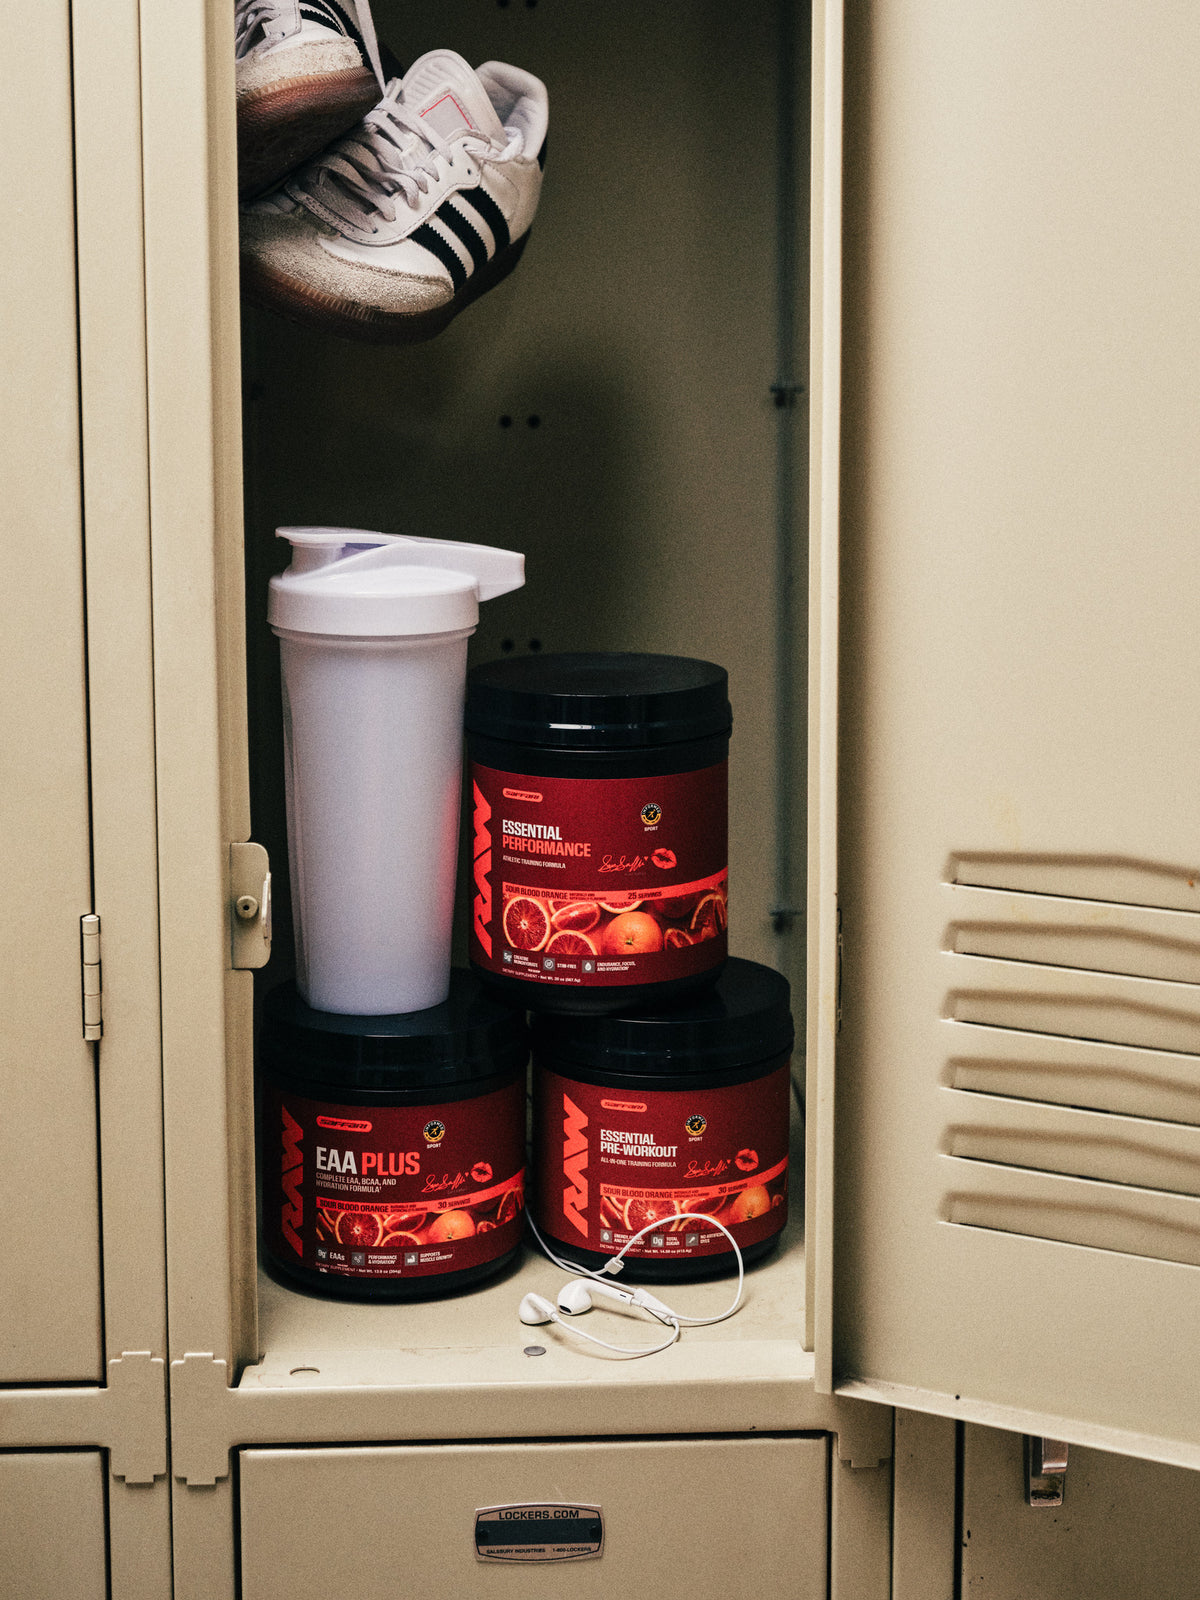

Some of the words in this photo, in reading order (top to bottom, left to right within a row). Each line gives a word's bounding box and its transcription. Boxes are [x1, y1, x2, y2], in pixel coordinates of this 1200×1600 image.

[502, 819, 562, 840] ESSENTIAL
[502, 834, 591, 857] PERFORMANCE
[502, 855, 521, 864] ATHLETIC
[521, 858, 542, 867] TRAINING
[542, 860, 566, 869] FORMULA
[505, 884, 520, 894] SOUR
[521, 887, 541, 897] BLOOD
[542, 890, 568, 900] ORANGE
[600, 1129, 656, 1145] ESSENTIAL
[600, 1141, 678, 1158] PRE-WORKOUT
[316, 1146, 357, 1174] EAA
[361, 1152, 420, 1176] PLUS
[601, 1156, 627, 1166] ALL-IN-ONE
[316, 1172, 346, 1184] COMPLETE
[346, 1176, 361, 1185] EAA,
[316, 1180, 348, 1191] HYDRATION
[603, 1186, 621, 1195] SOUR
[621, 1189, 644, 1198] BLOOD
[337, 1202, 359, 1211] BLOOD
[360, 1204, 389, 1212] ORANGE
[448, 1198, 470, 1207] SERVINGS
[652, 1237, 663, 1246] 0g
[330, 1252, 345, 1260] EAAs
[499, 1510, 579, 1520] LOCKERS.COM
